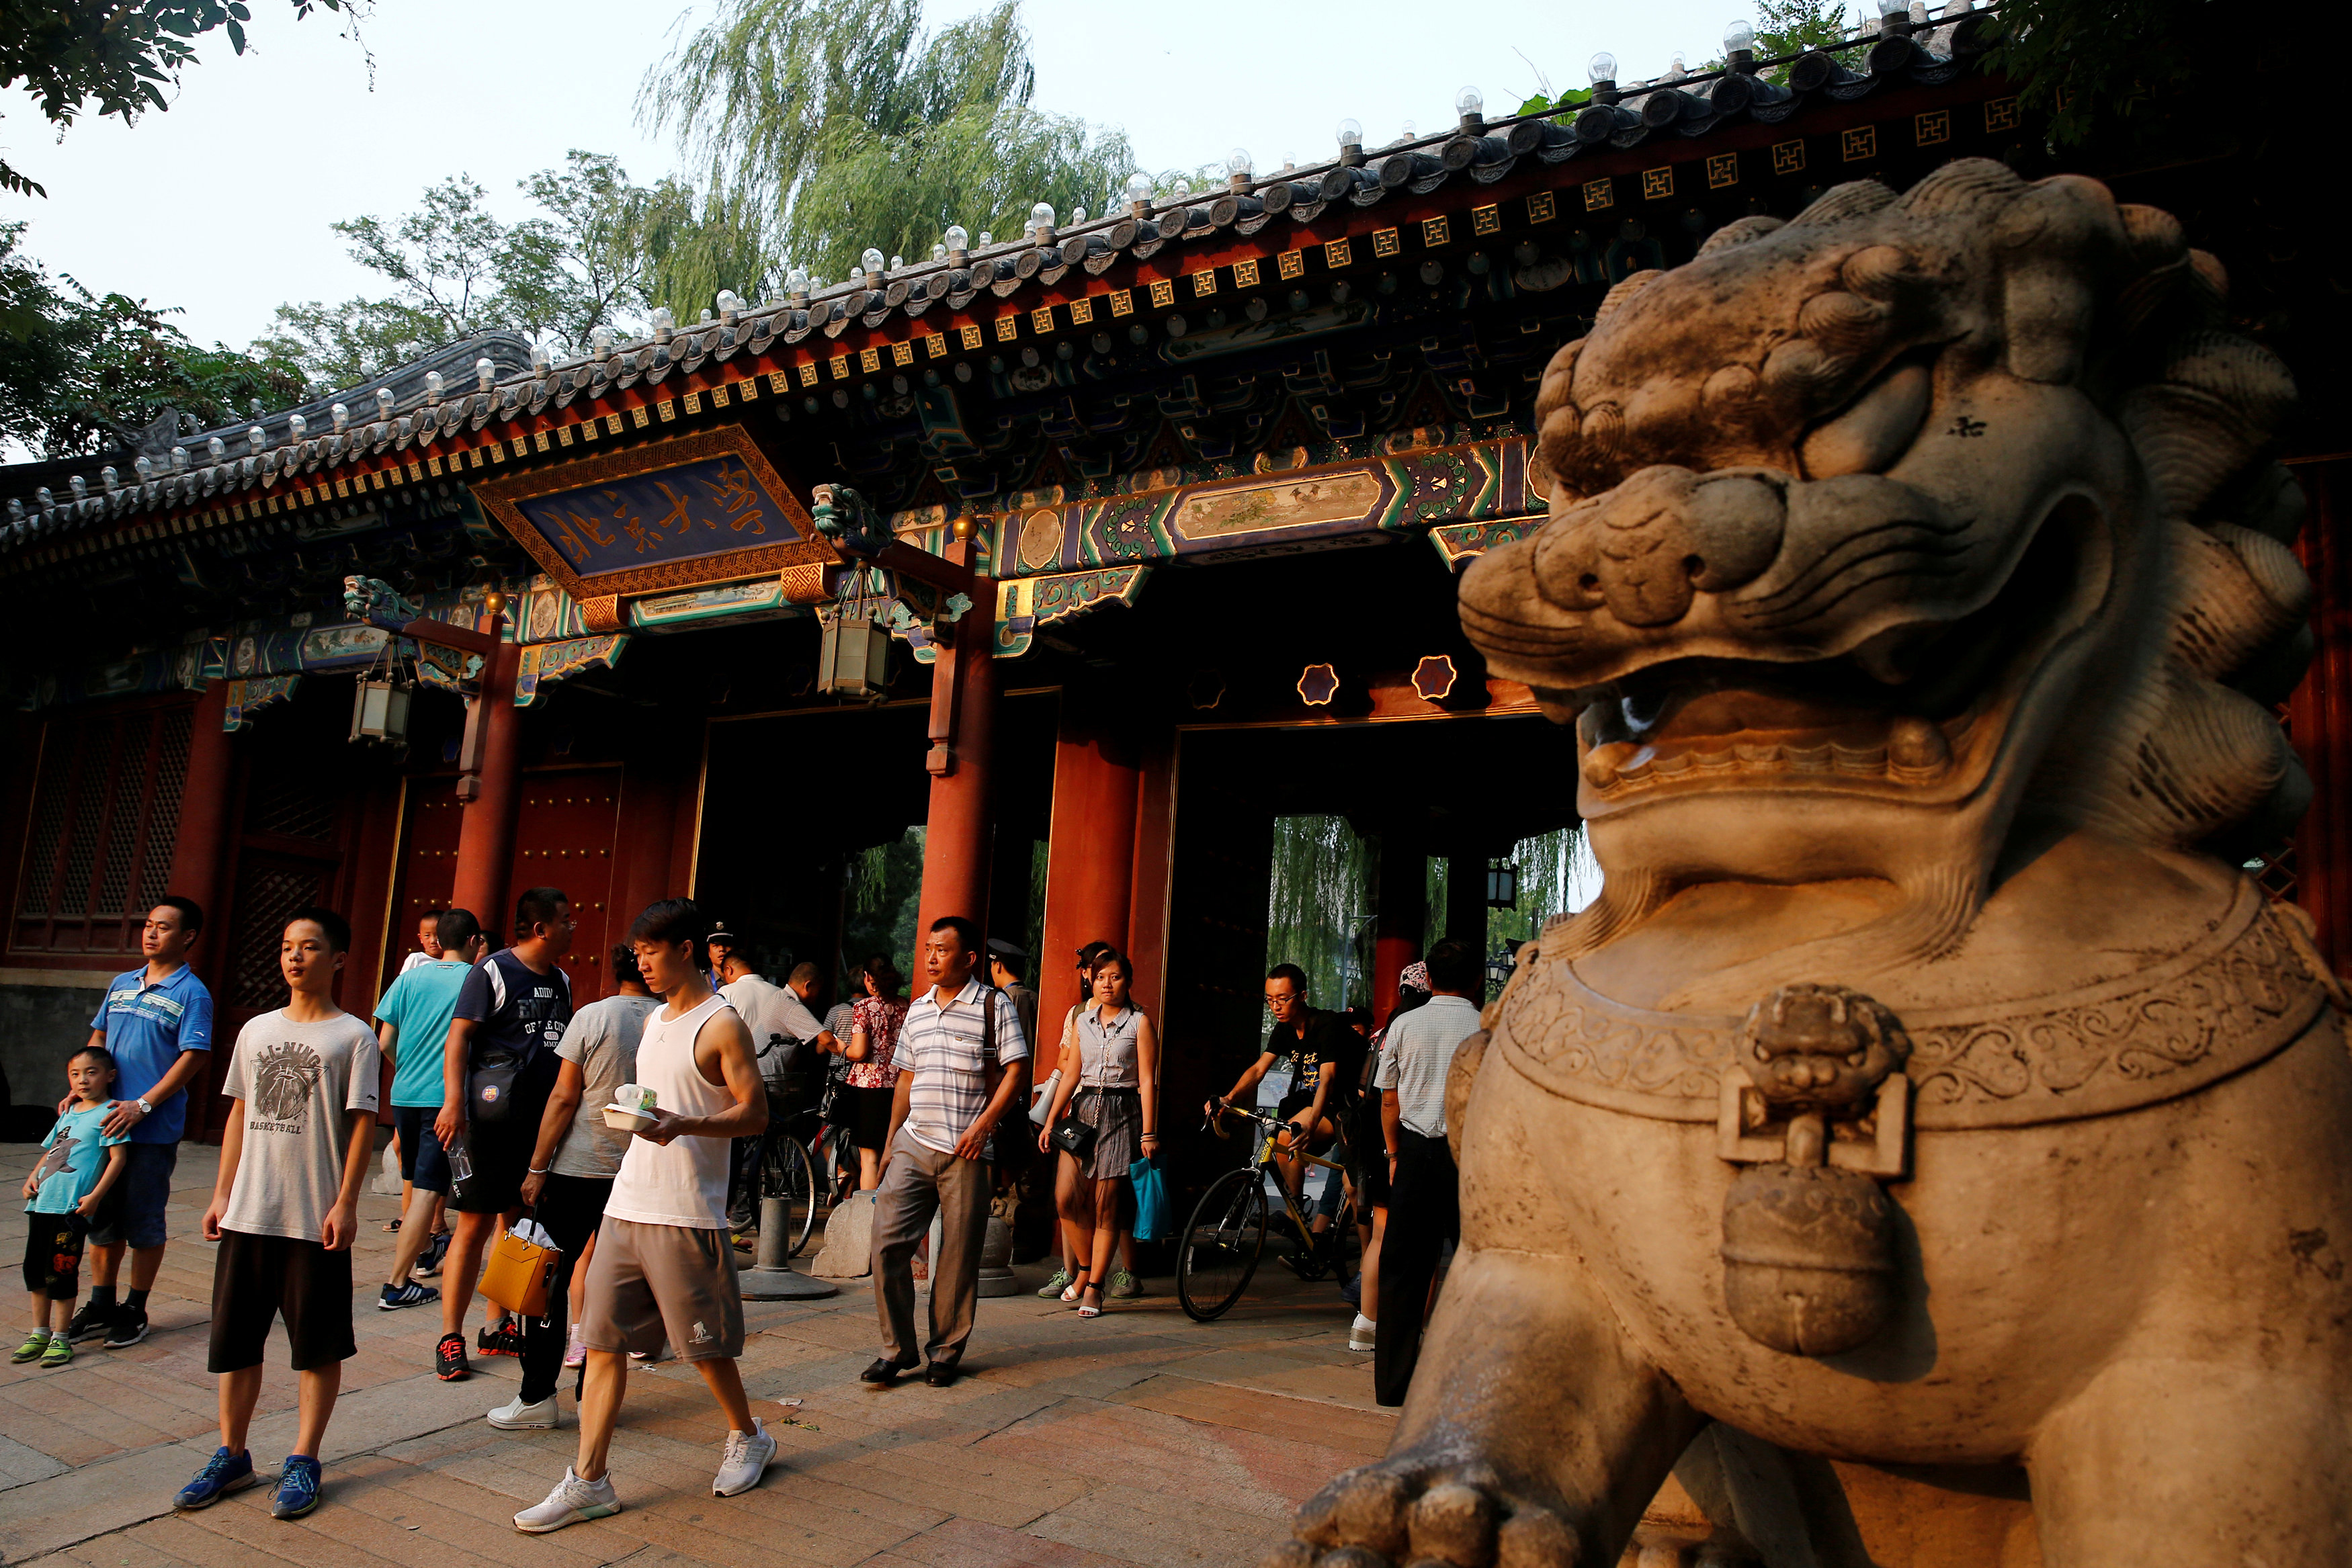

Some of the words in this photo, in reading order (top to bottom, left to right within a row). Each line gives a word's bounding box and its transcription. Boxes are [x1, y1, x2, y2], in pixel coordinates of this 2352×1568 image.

[524, 1022, 536, 1034] OF
[257, 1041, 321, 1067] LI-NING
[249, 1121, 301, 1135] BASKETBALL
